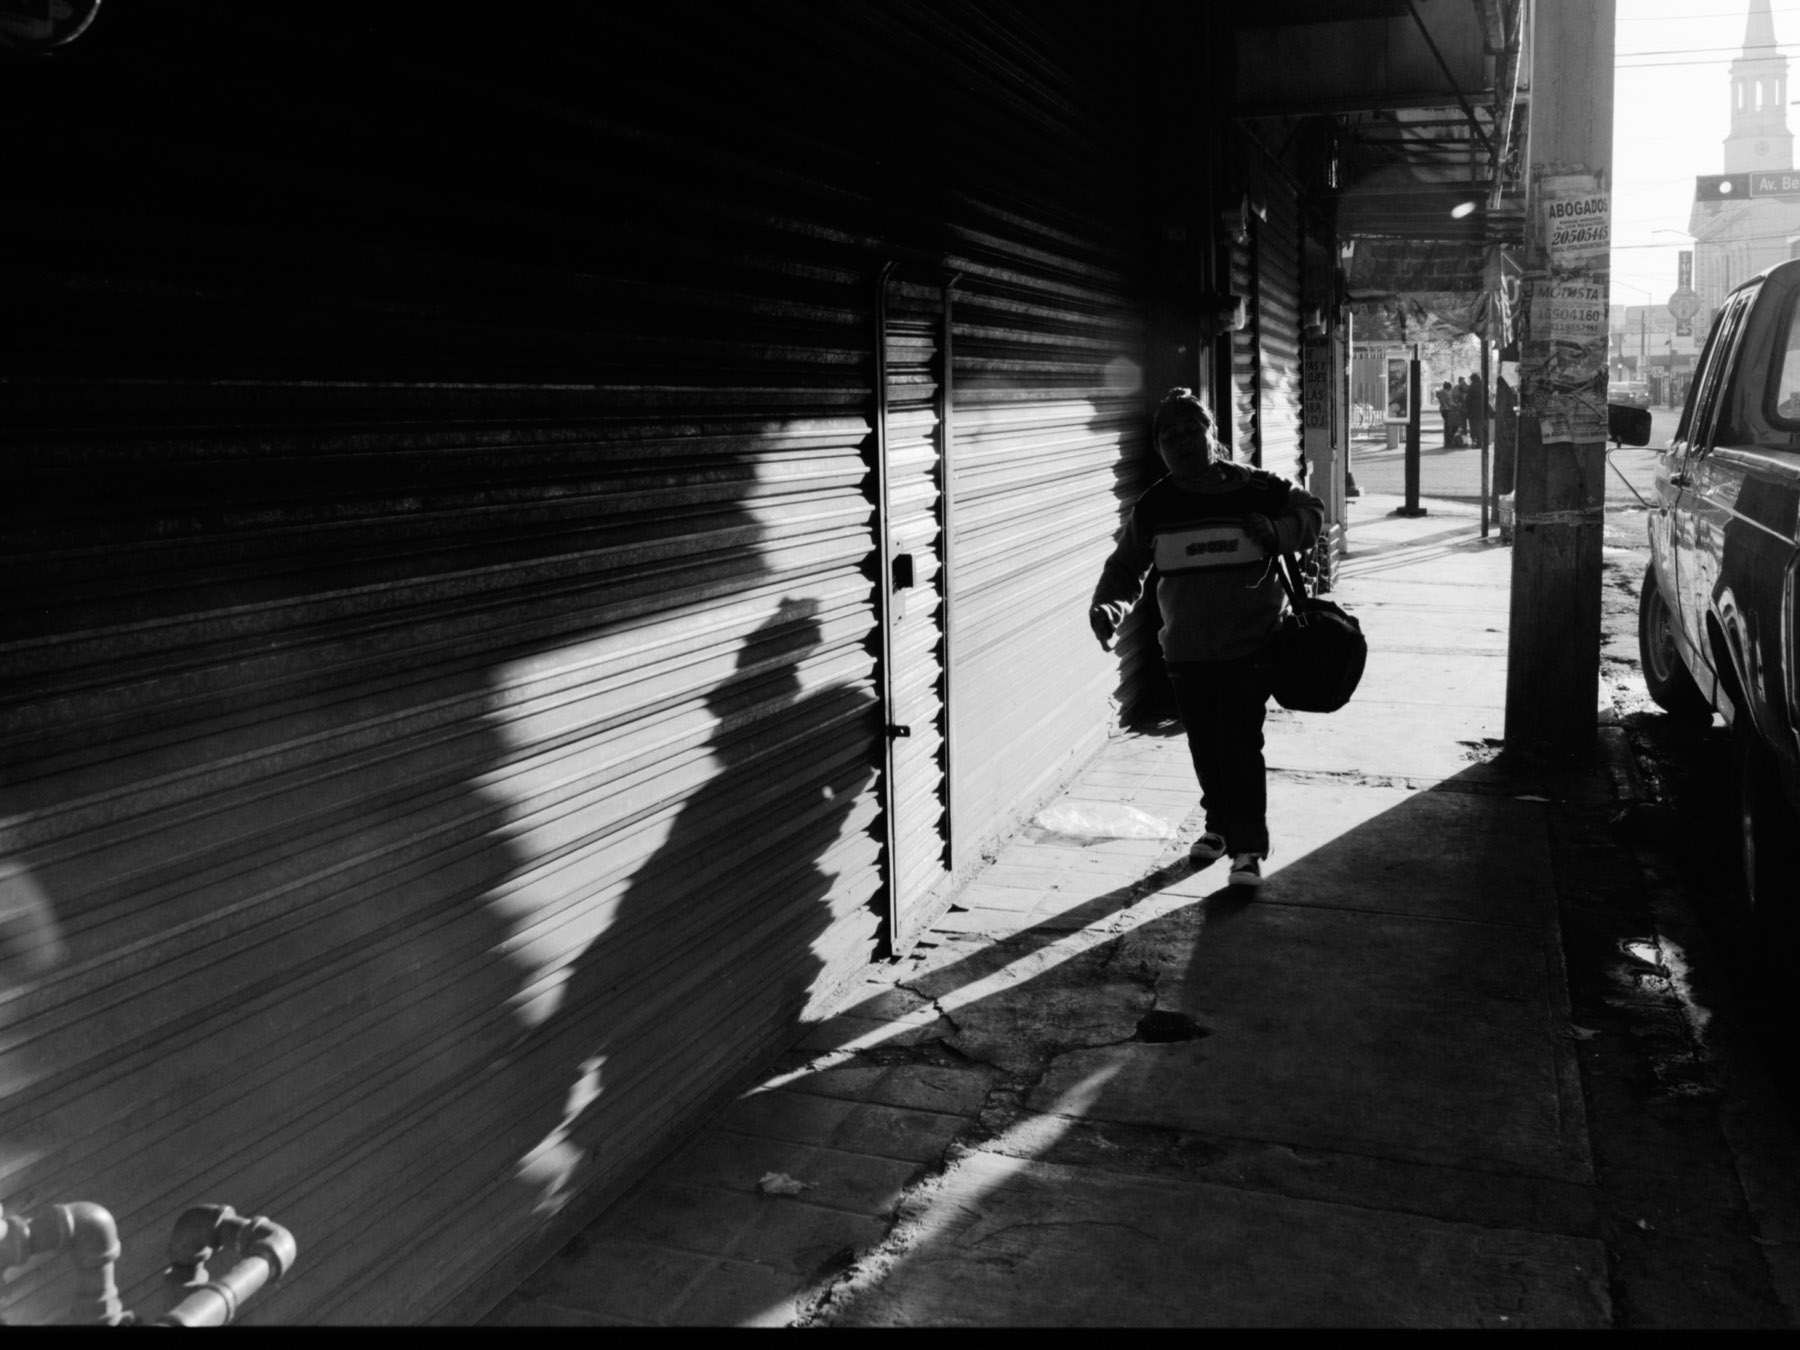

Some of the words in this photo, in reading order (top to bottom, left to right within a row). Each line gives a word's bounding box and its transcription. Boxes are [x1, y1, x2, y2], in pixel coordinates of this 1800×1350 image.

[1759, 177, 1777, 191] Av.
[1548, 198, 1608, 220] ABOGADOS
[1551, 226, 1609, 246] 20505445
